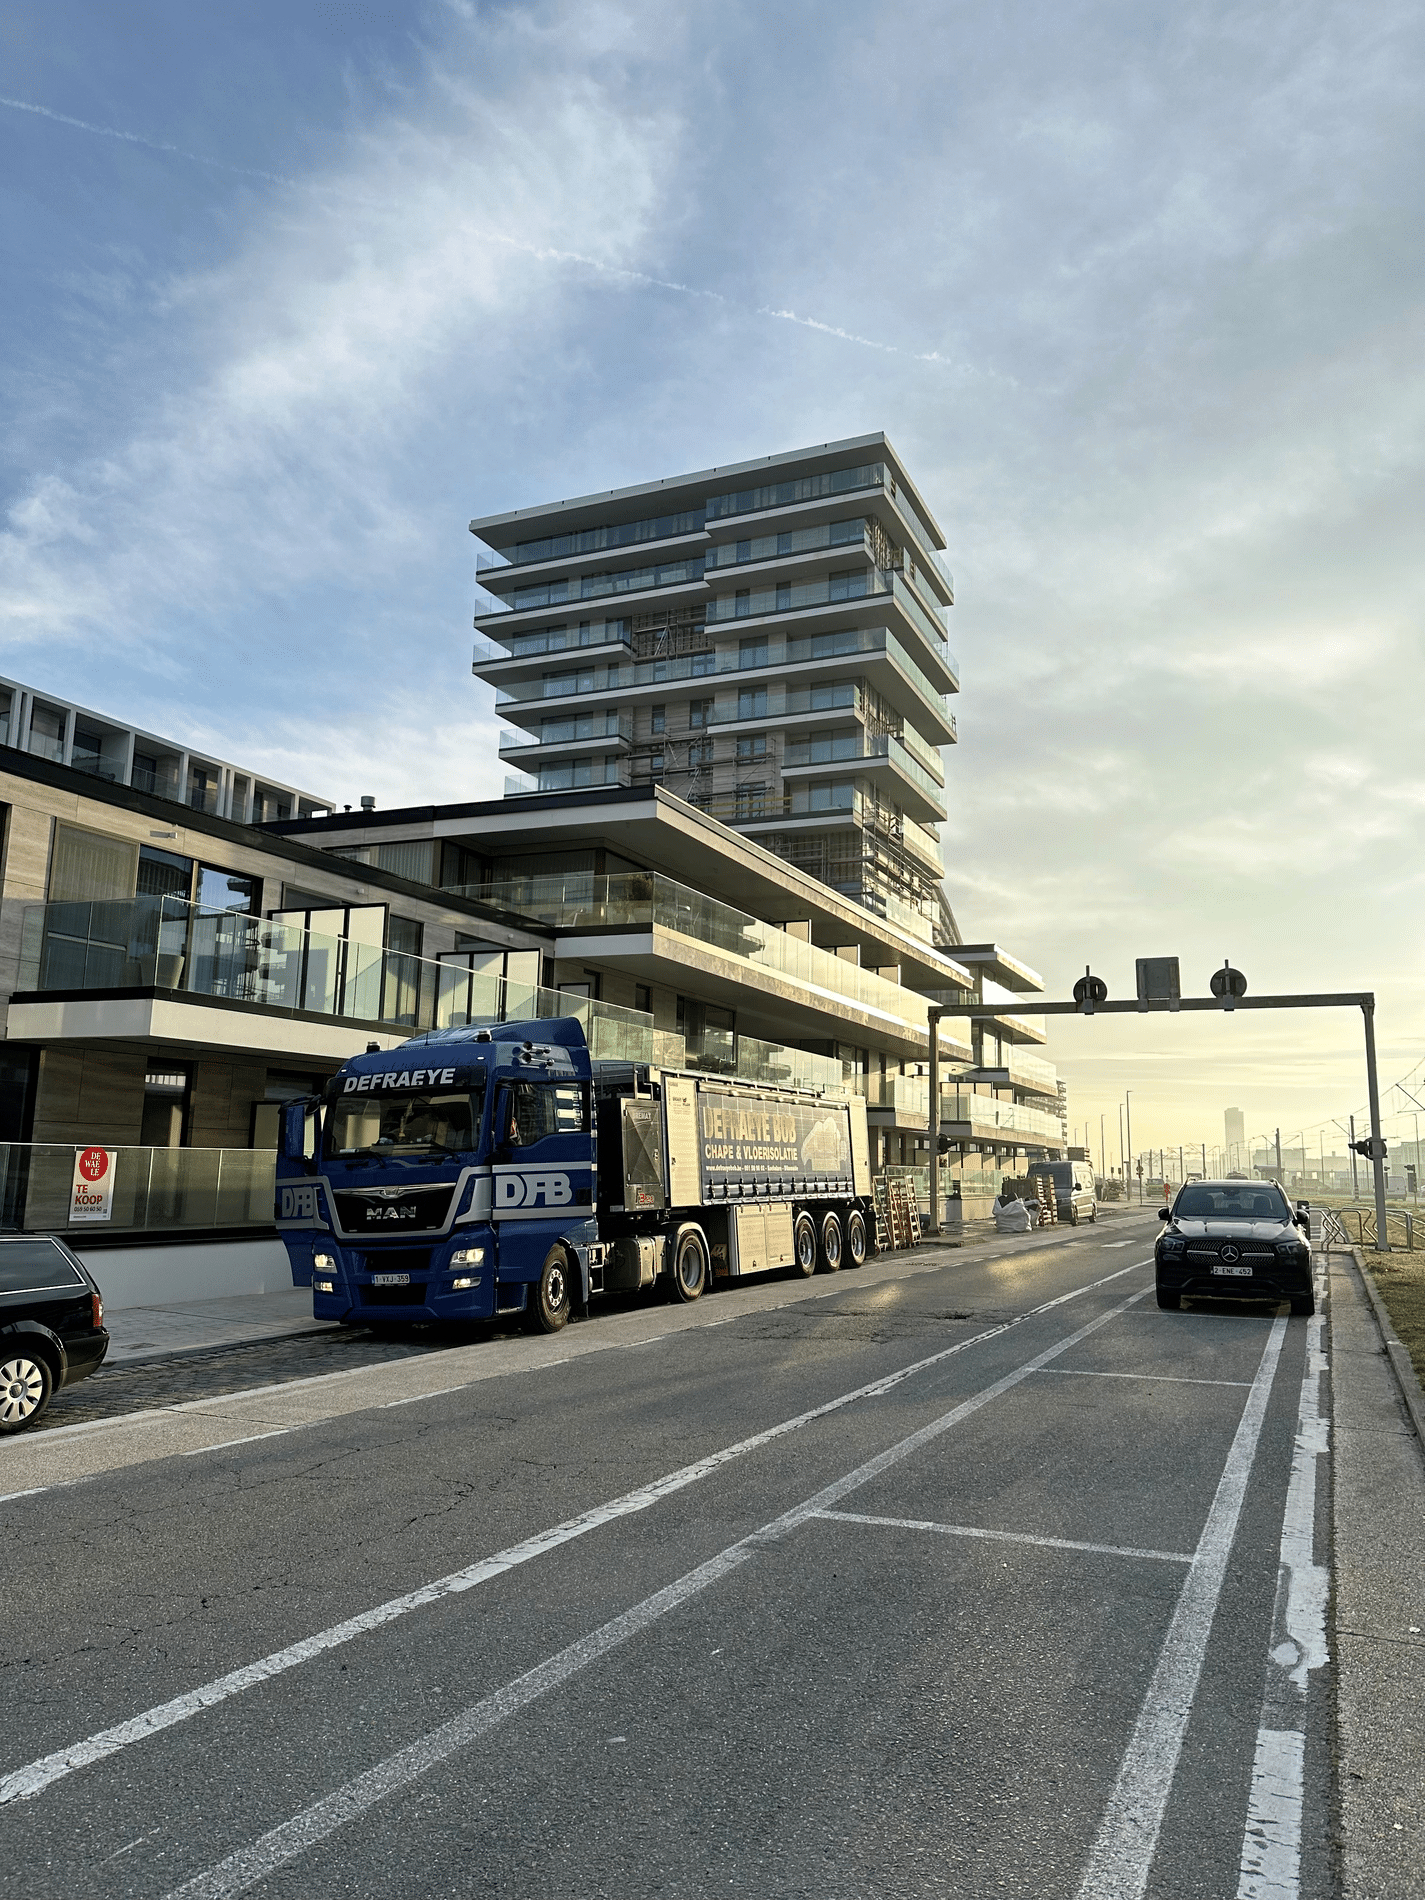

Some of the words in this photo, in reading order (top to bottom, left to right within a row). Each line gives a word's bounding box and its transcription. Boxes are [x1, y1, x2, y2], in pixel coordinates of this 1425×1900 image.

[343, 1068, 456, 1093] DEFRAEYE
[91, 1152, 101, 1160] DE
[705, 1144, 734, 1159] CHAPE
[736, 1145, 742, 1160] &
[743, 1146, 798, 1161] VLOERISOLATIE
[76, 1184, 88, 1194] TE
[495, 1172, 573, 1207] DFB
[75, 1194, 103, 1205] KOOP
[281, 1186, 314, 1217] DFB
[366, 1206, 417, 1220] MAN
